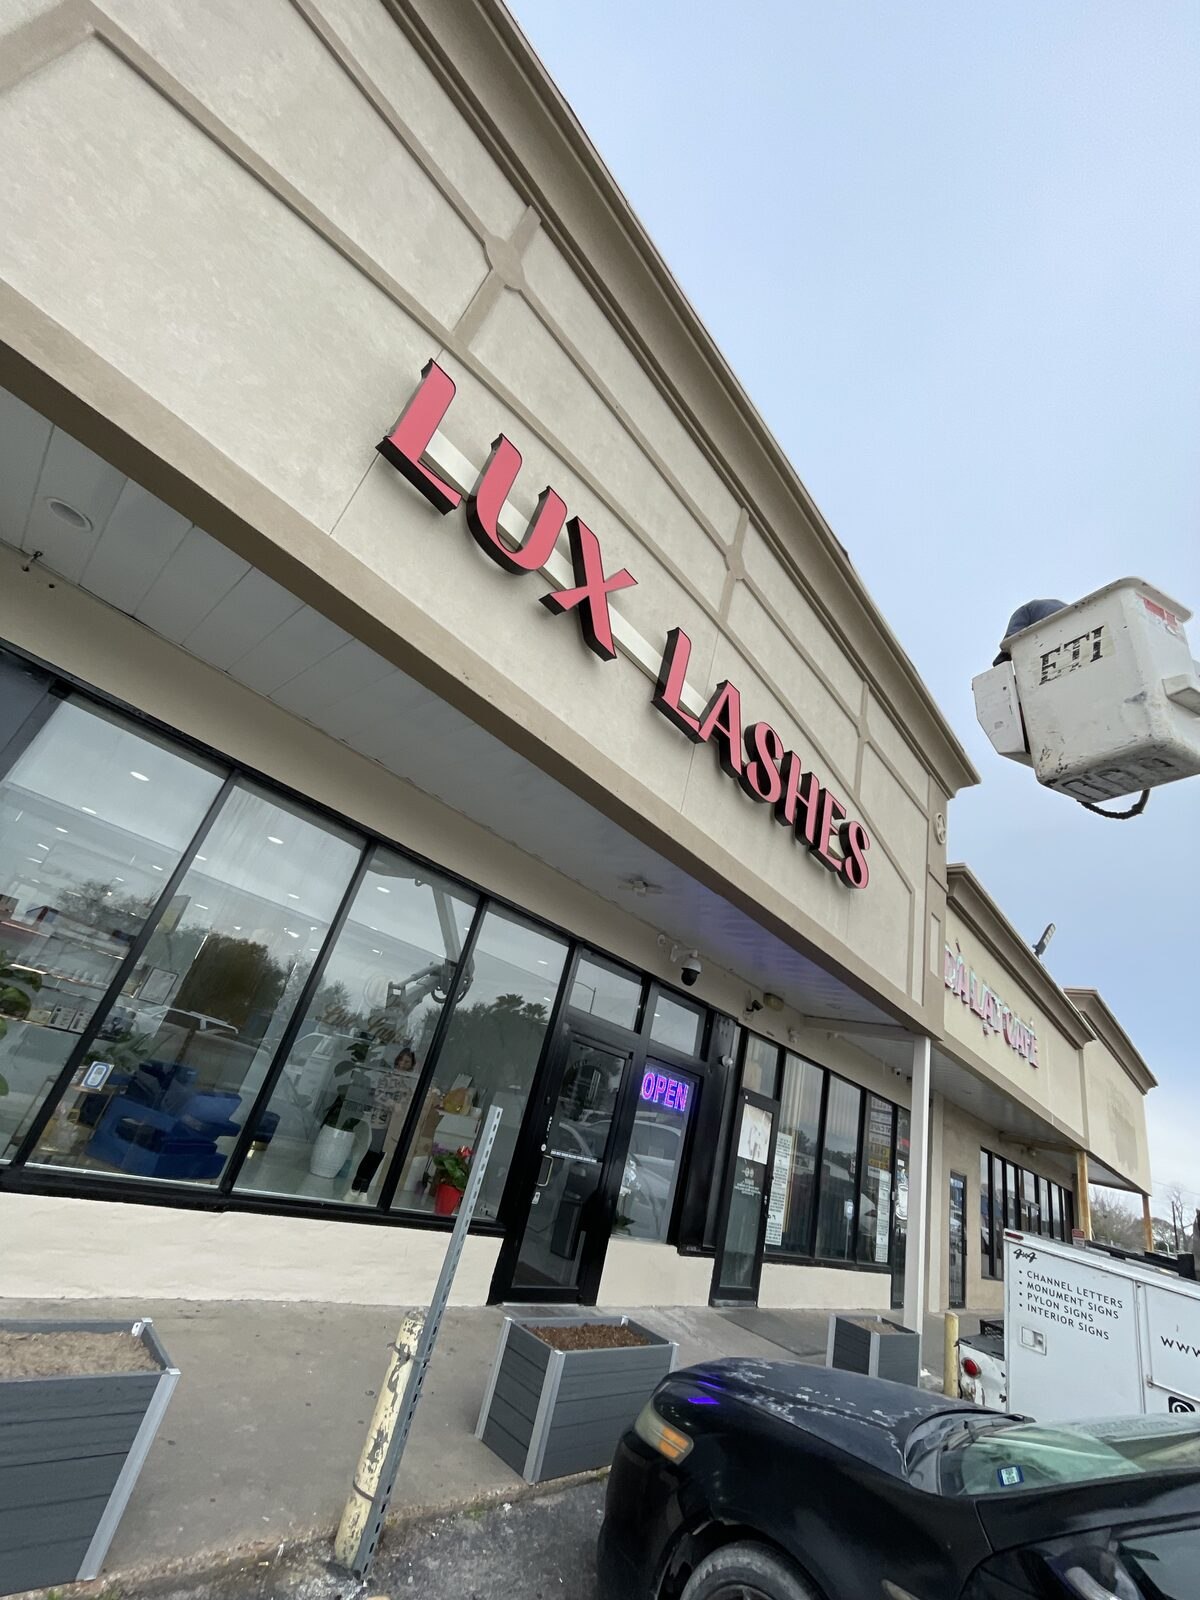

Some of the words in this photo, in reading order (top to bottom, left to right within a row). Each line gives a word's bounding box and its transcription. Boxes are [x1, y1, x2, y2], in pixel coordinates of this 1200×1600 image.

[376, 359, 638, 662] LUX
[651, 627, 870, 890] LASHES
[641, 1072, 689, 1112] OPEN
[1027, 1270, 1073, 1292] CHANNEL
[1076, 1287, 1123, 1309] LETTERS
[1027, 1281, 1084, 1306] MONUMENT
[1088, 1302, 1119, 1320] SIGNS
[1027, 1292, 1060, 1310] PYLON
[1063, 1305, 1094, 1322] SIGNS
[1027, 1303, 1074, 1327] INTERIOR
[1078, 1322, 1109, 1340] SIGNS
